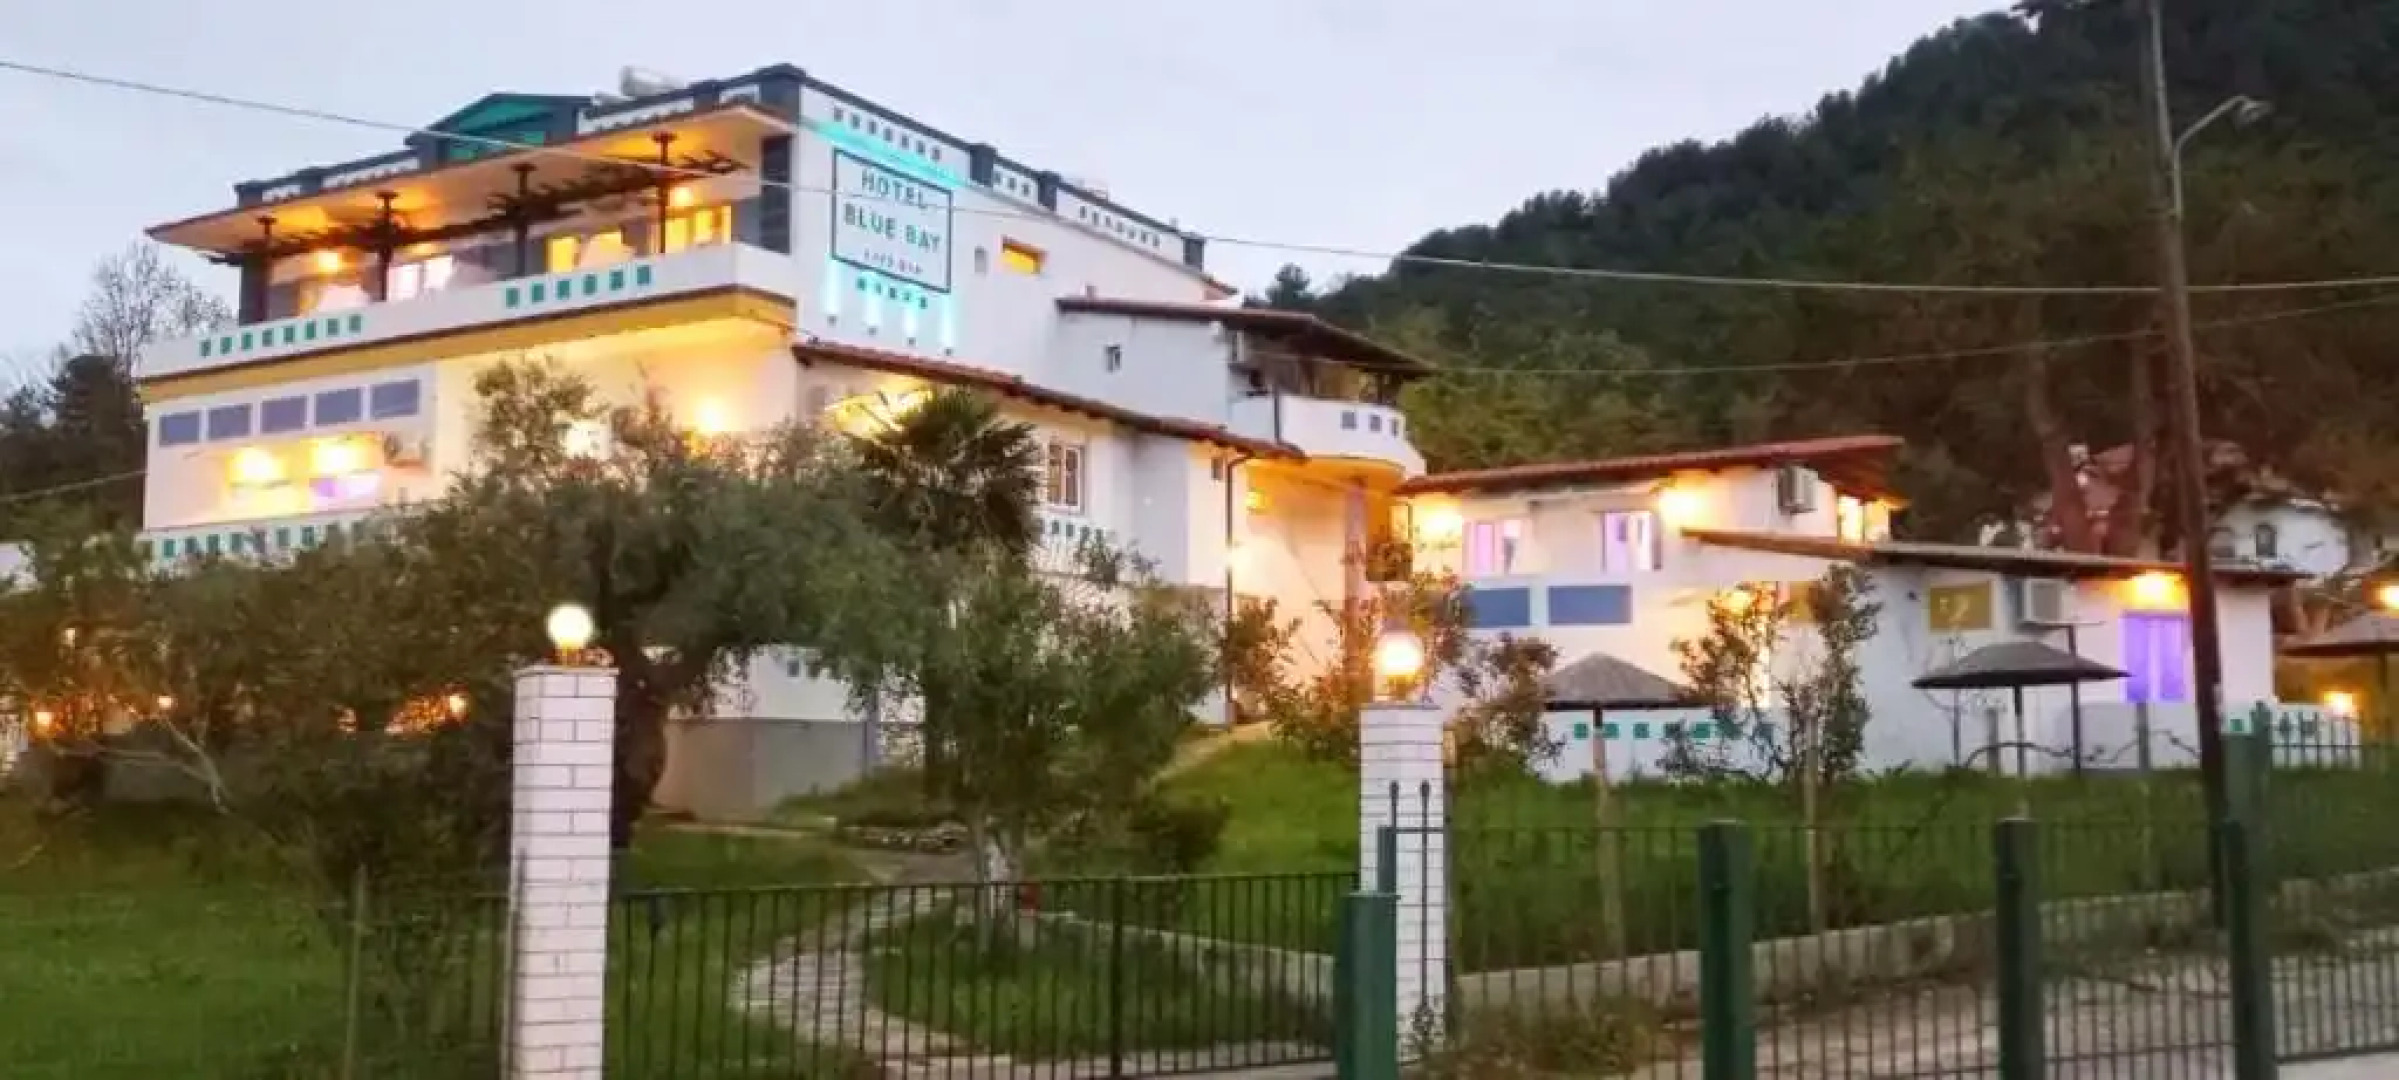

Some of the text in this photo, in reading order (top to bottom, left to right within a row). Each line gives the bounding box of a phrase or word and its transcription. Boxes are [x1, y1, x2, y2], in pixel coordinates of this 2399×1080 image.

[861, 168, 928, 208] HOTEL
[844, 203, 941, 253] BLUE BAY
